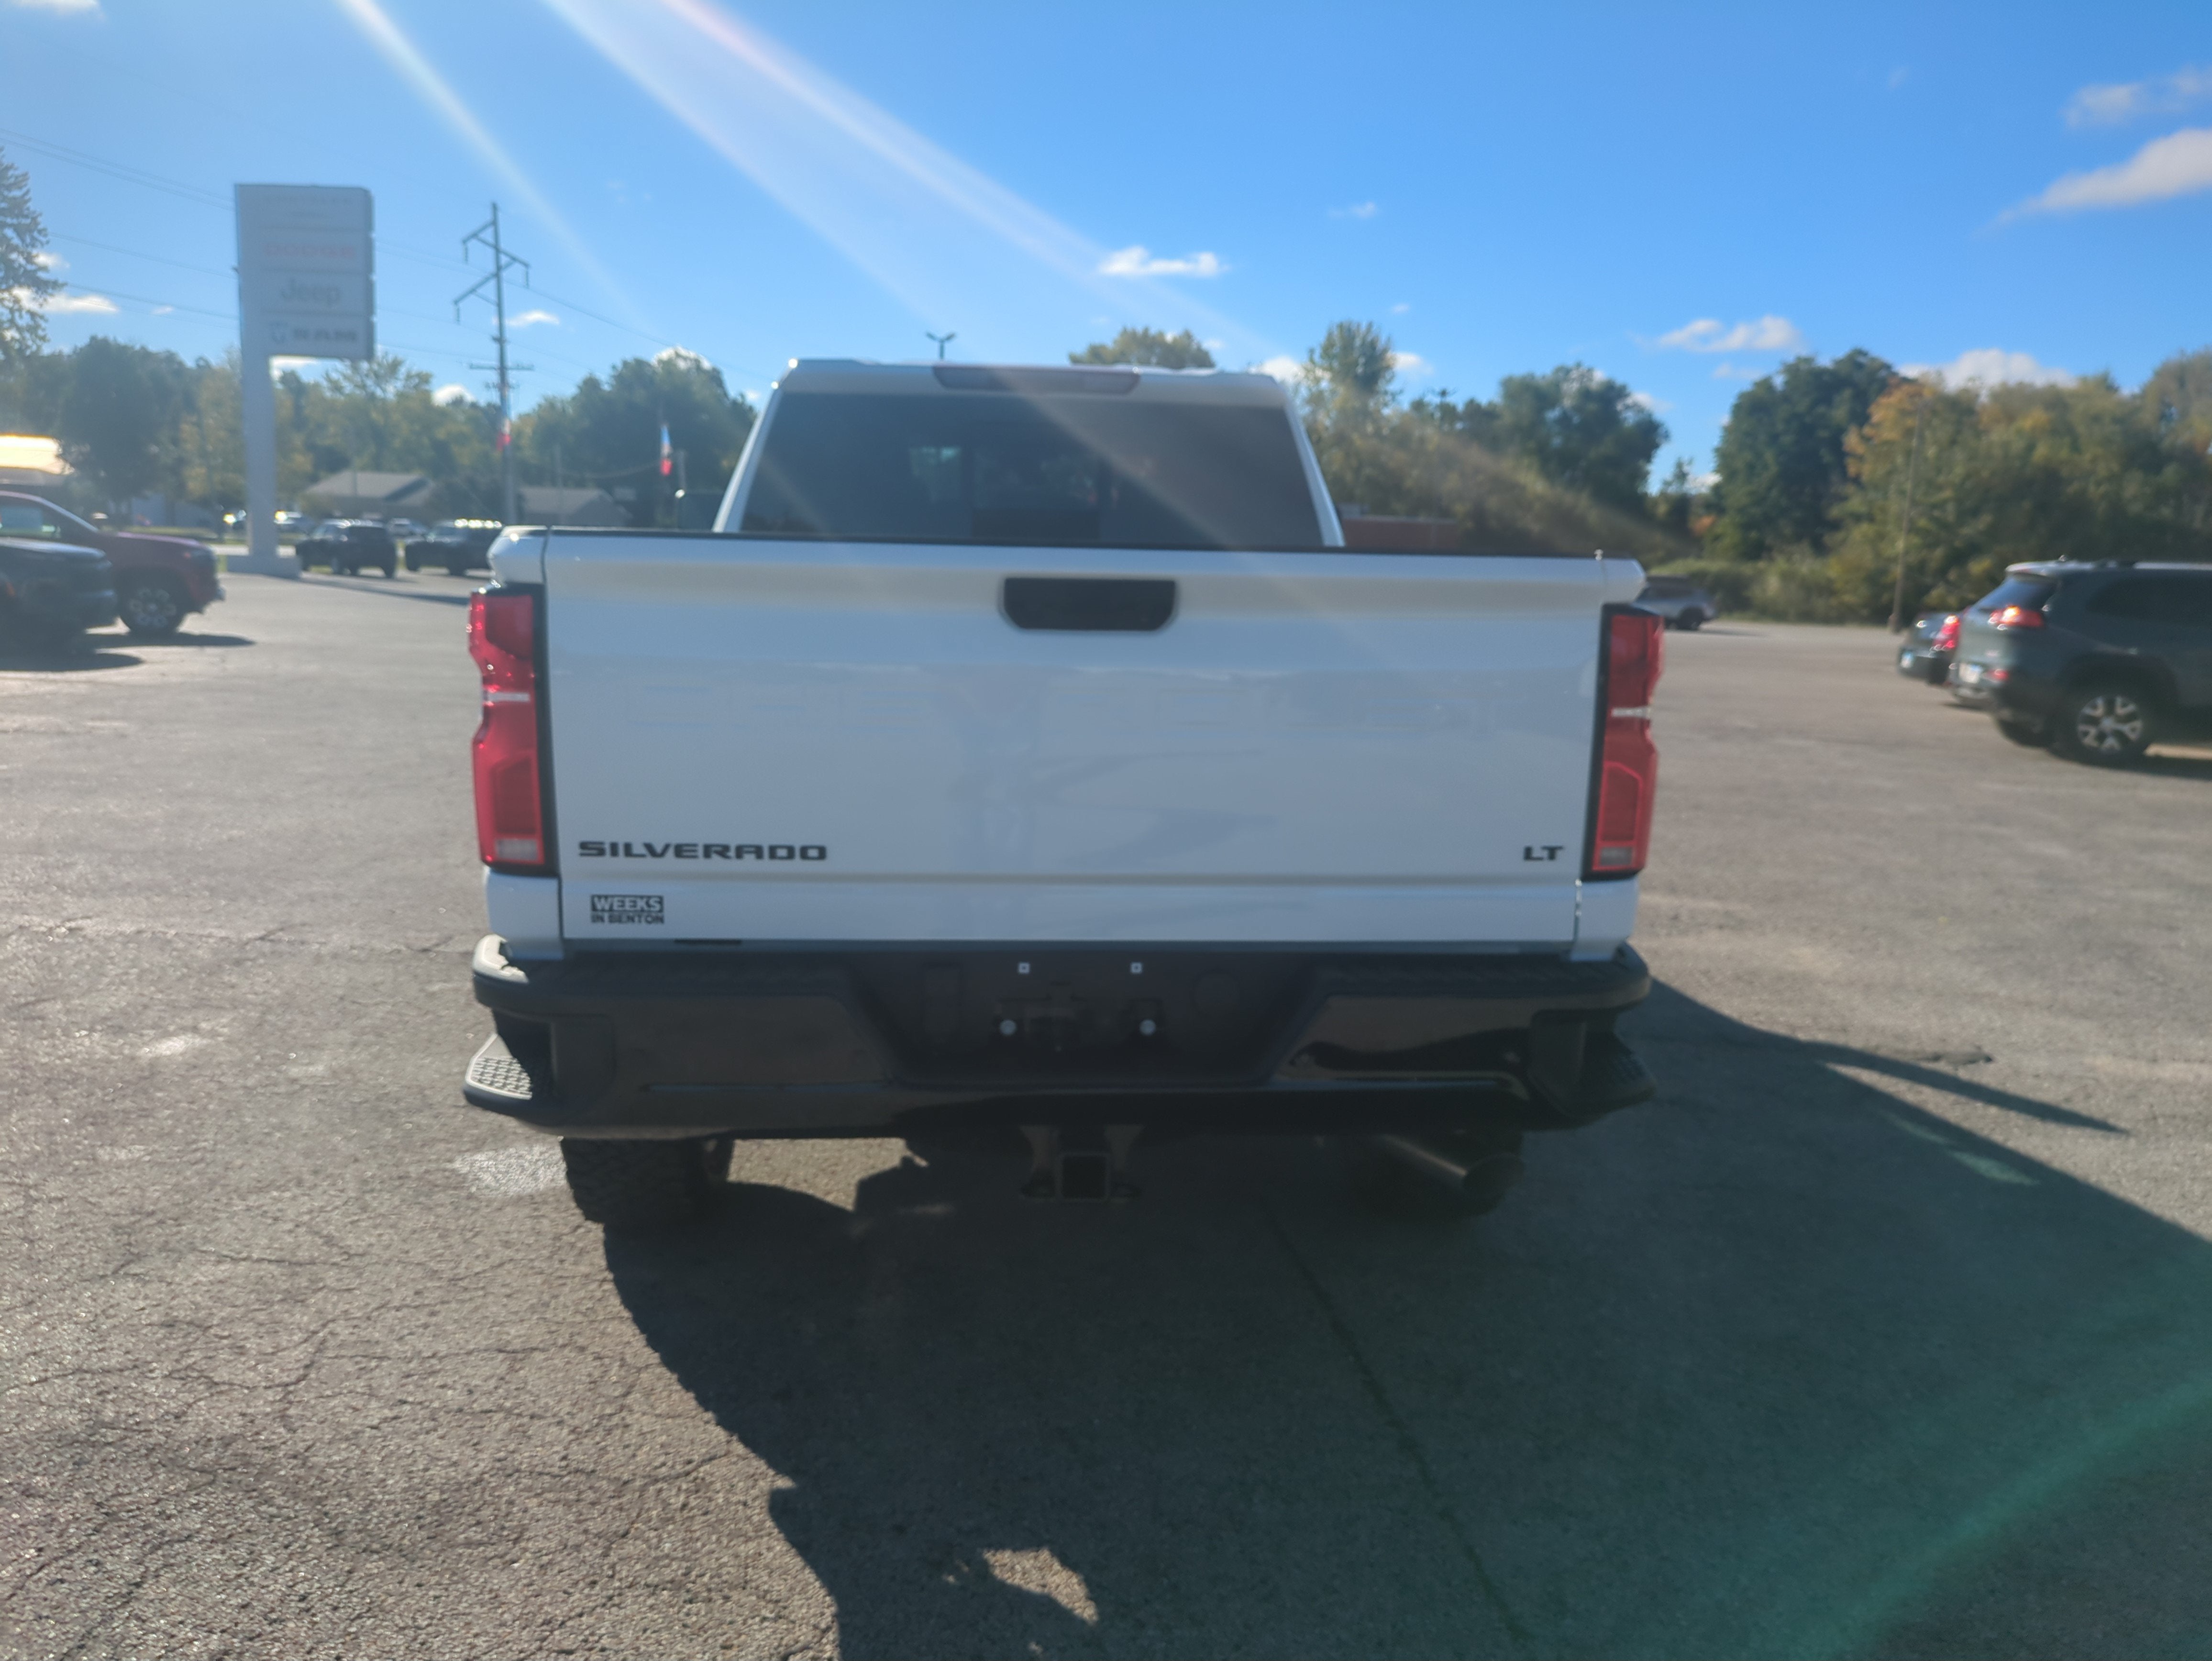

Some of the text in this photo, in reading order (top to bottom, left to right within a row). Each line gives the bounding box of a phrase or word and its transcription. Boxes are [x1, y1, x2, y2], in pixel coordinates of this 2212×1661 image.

[579, 841, 827, 861] SILVERADO
[1523, 845, 1564, 861] LT
[593, 896, 662, 911] WEEKS
[591, 913, 664, 925] IN BENTON
